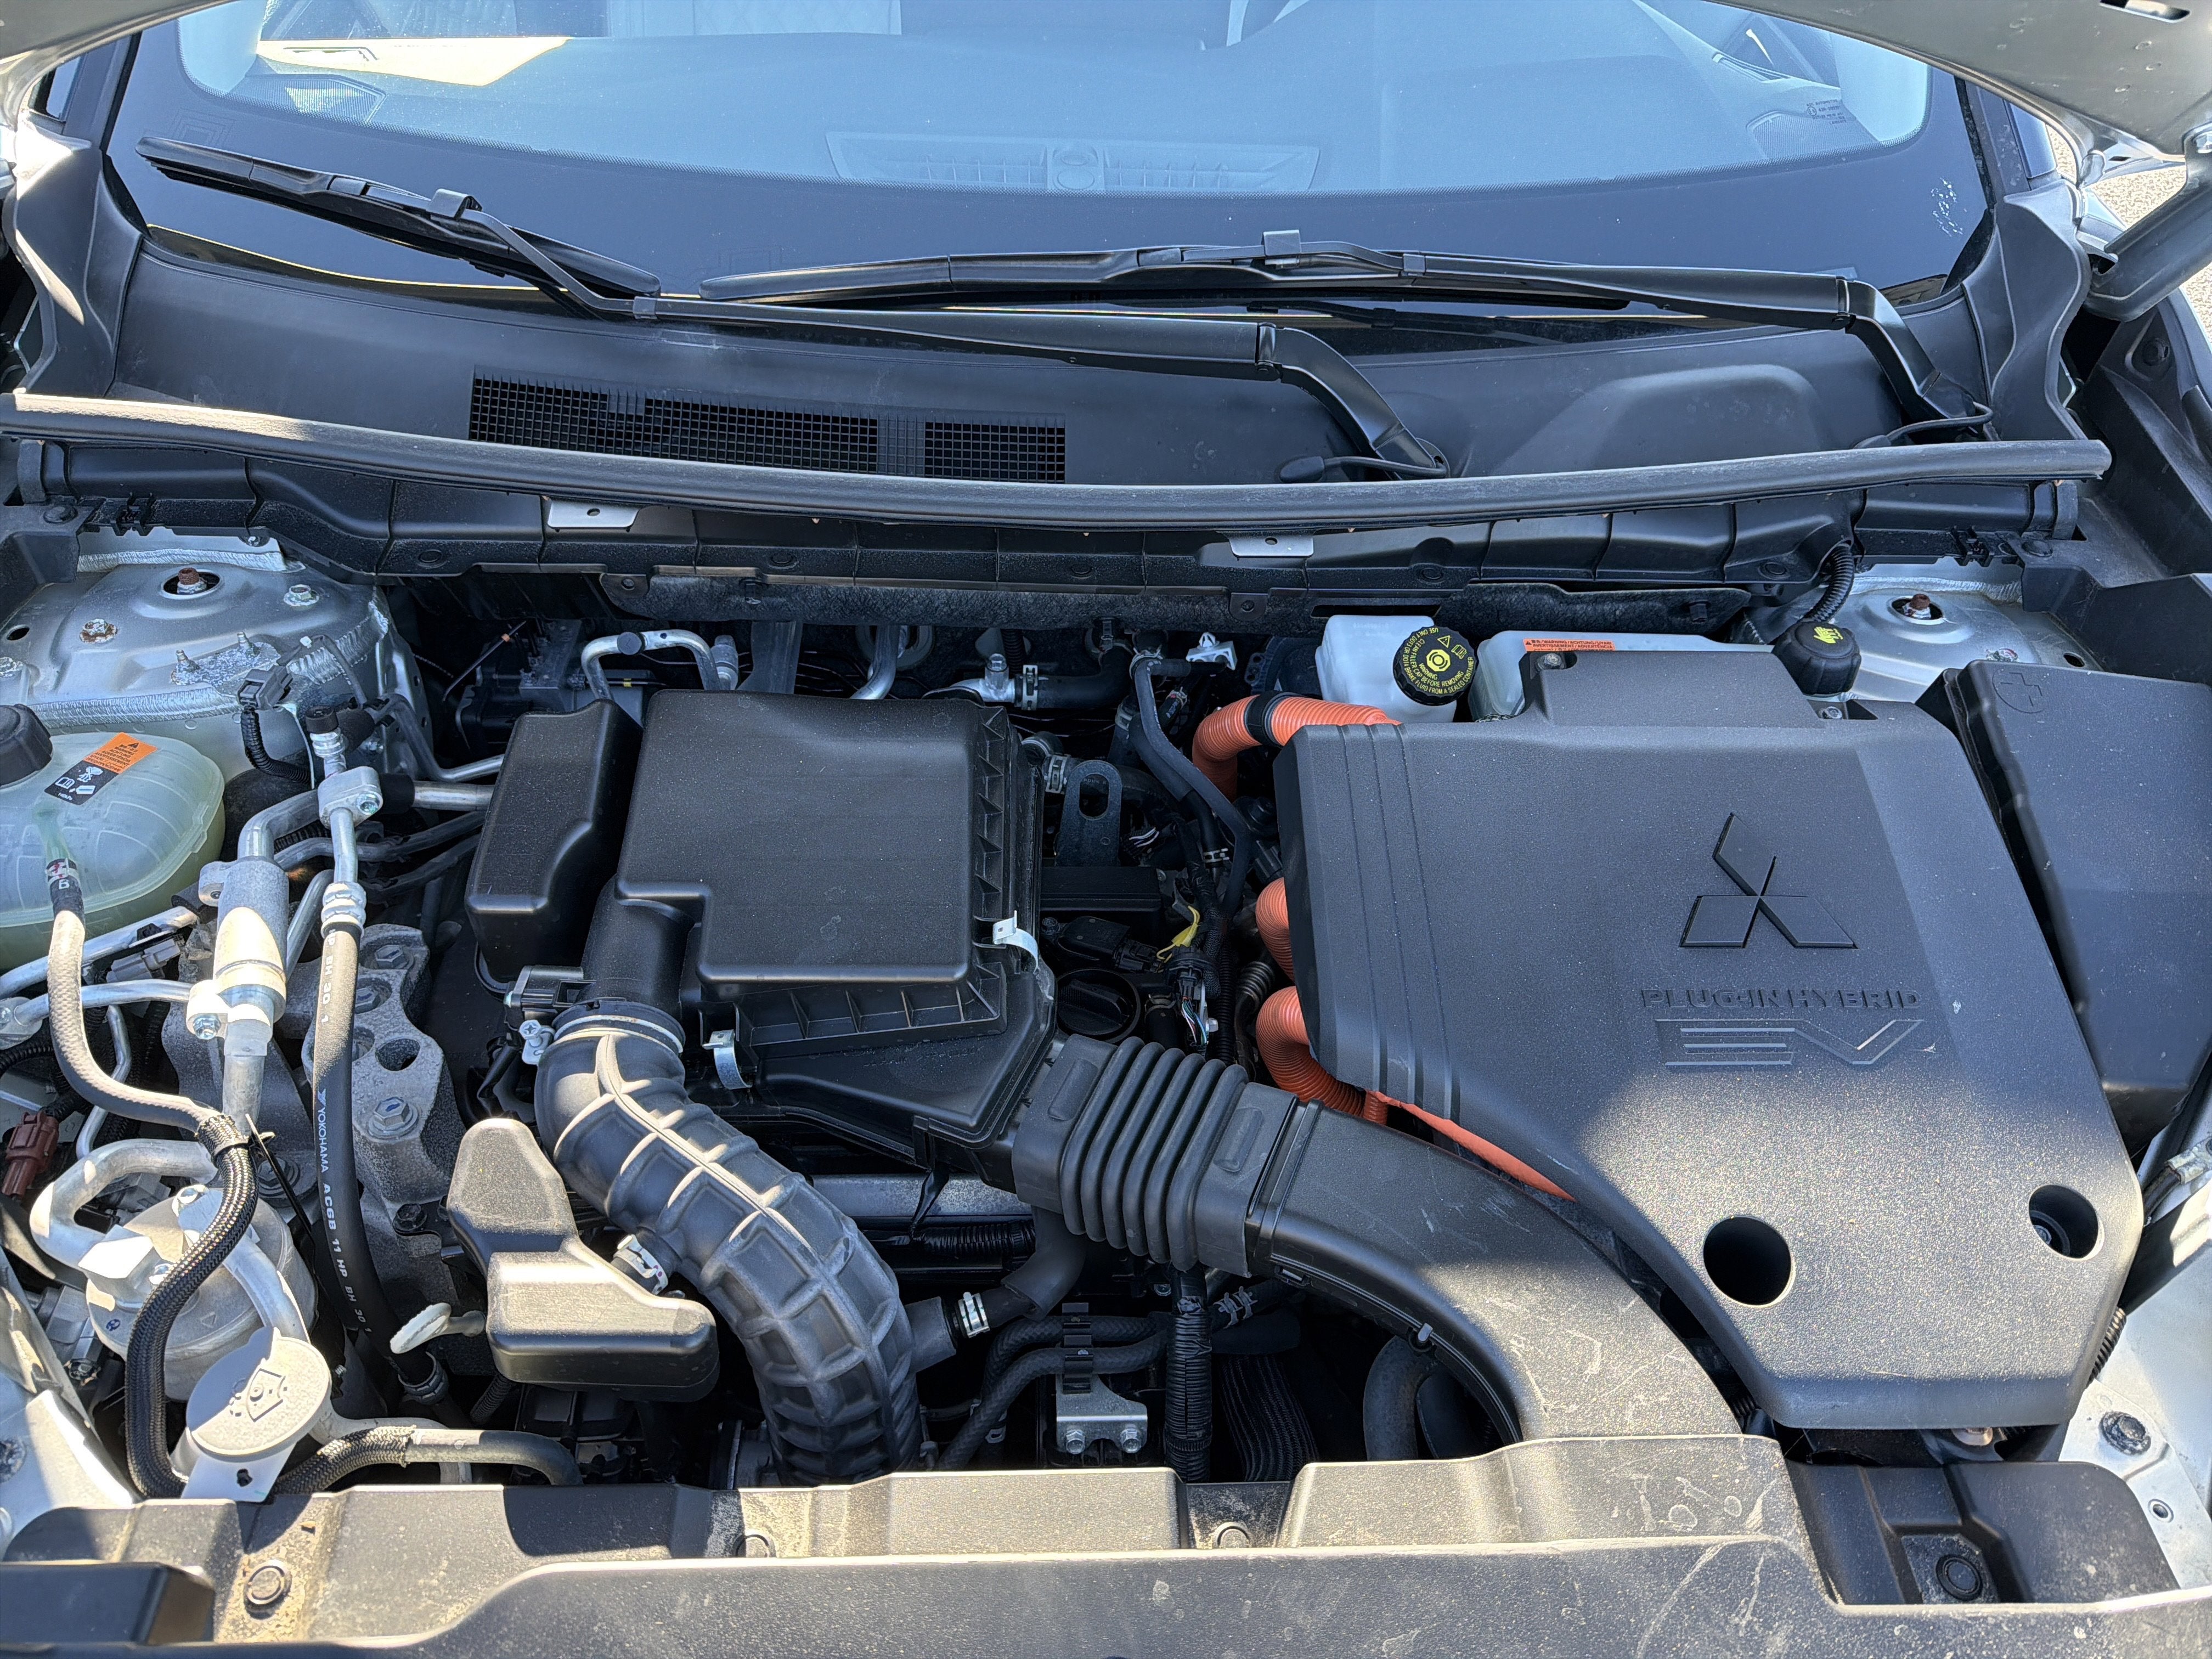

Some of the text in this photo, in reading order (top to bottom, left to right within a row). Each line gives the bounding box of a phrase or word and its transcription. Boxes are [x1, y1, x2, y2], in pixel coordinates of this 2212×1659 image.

[1417, 629, 1428, 638] ONLY
[1412, 639, 1425, 653] CLEAN
[1404, 667, 1417, 681] BRAKE
[1413, 668, 1423, 678] CAP
[1419, 663, 1438, 680] WARNING
[1463, 657, 1474, 682] CONTAINER
[1415, 680, 1429, 691] FLUID
[1420, 676, 1440, 687] BEFORE
[1442, 670, 1464, 687] REMOVING
[1448, 682, 1465, 693] SEALED
[325, 955, 334, 975] BH
[322, 982, 332, 1005] 30
[1641, 988, 1922, 1009] PLUG-IN HYBRID
[1654, 1019, 1925, 1066] EV
[317, 1107, 329, 1173] YOKOHAMA
[332, 1238, 342, 1252] 11
[336, 1259, 348, 1277] HP
[345, 1285, 357, 1302] BH
[354, 1308, 366, 1323] 30
